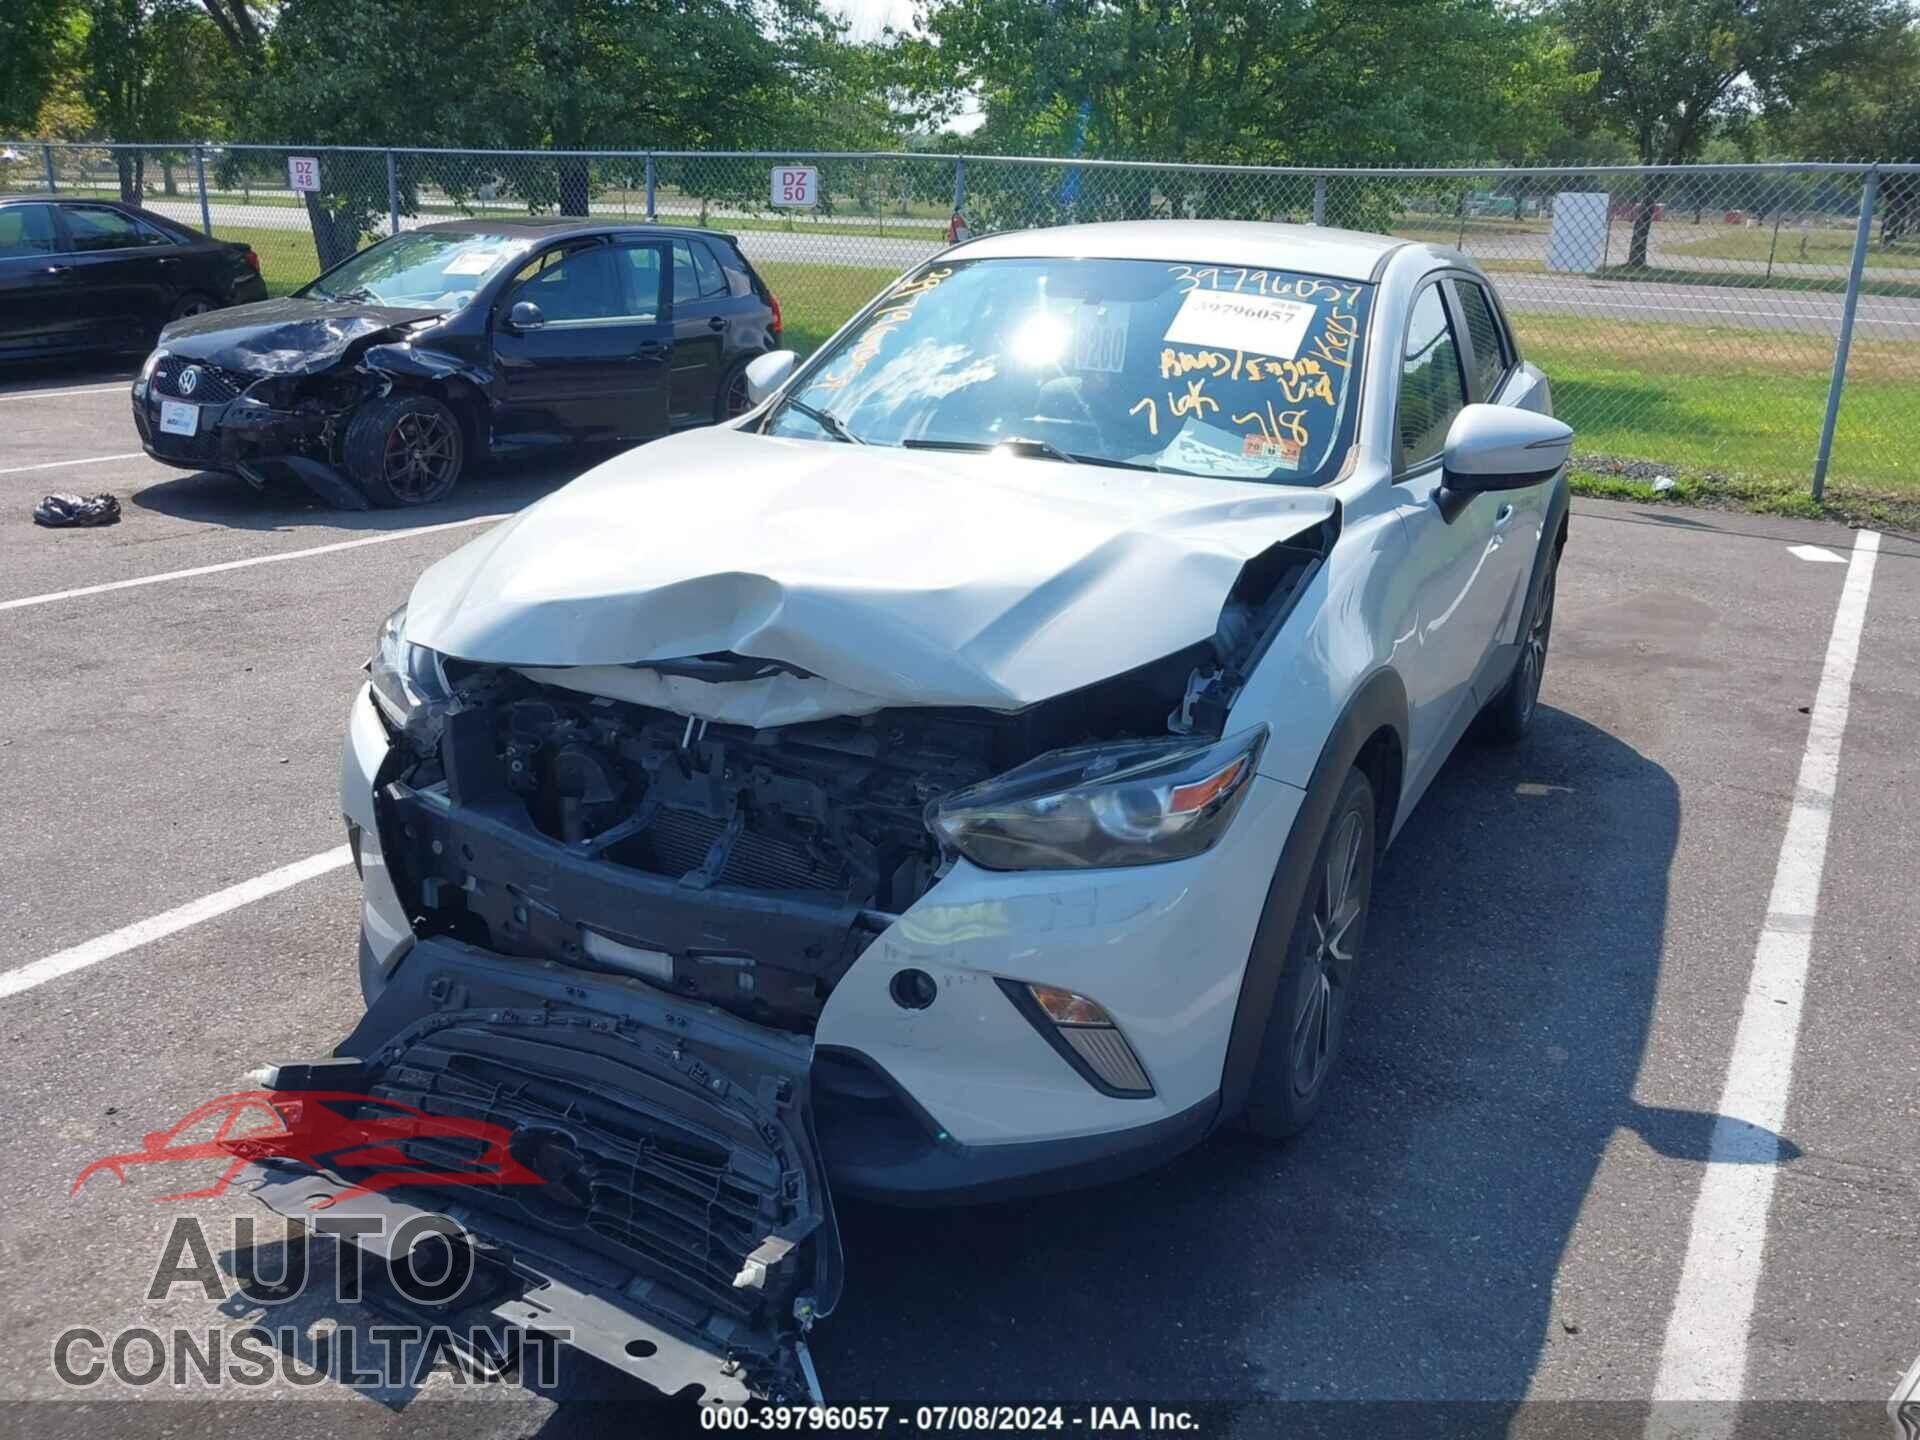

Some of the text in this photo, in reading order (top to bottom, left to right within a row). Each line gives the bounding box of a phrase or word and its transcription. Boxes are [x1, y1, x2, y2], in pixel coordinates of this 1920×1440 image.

[295, 161, 313, 174] DZ
[297, 174, 313, 186] 48
[783, 171, 807, 186] DZ
[783, 186, 806, 201] 50
[1167, 264, 1363, 307] 39796057
[1308, 306, 1361, 368] Keys
